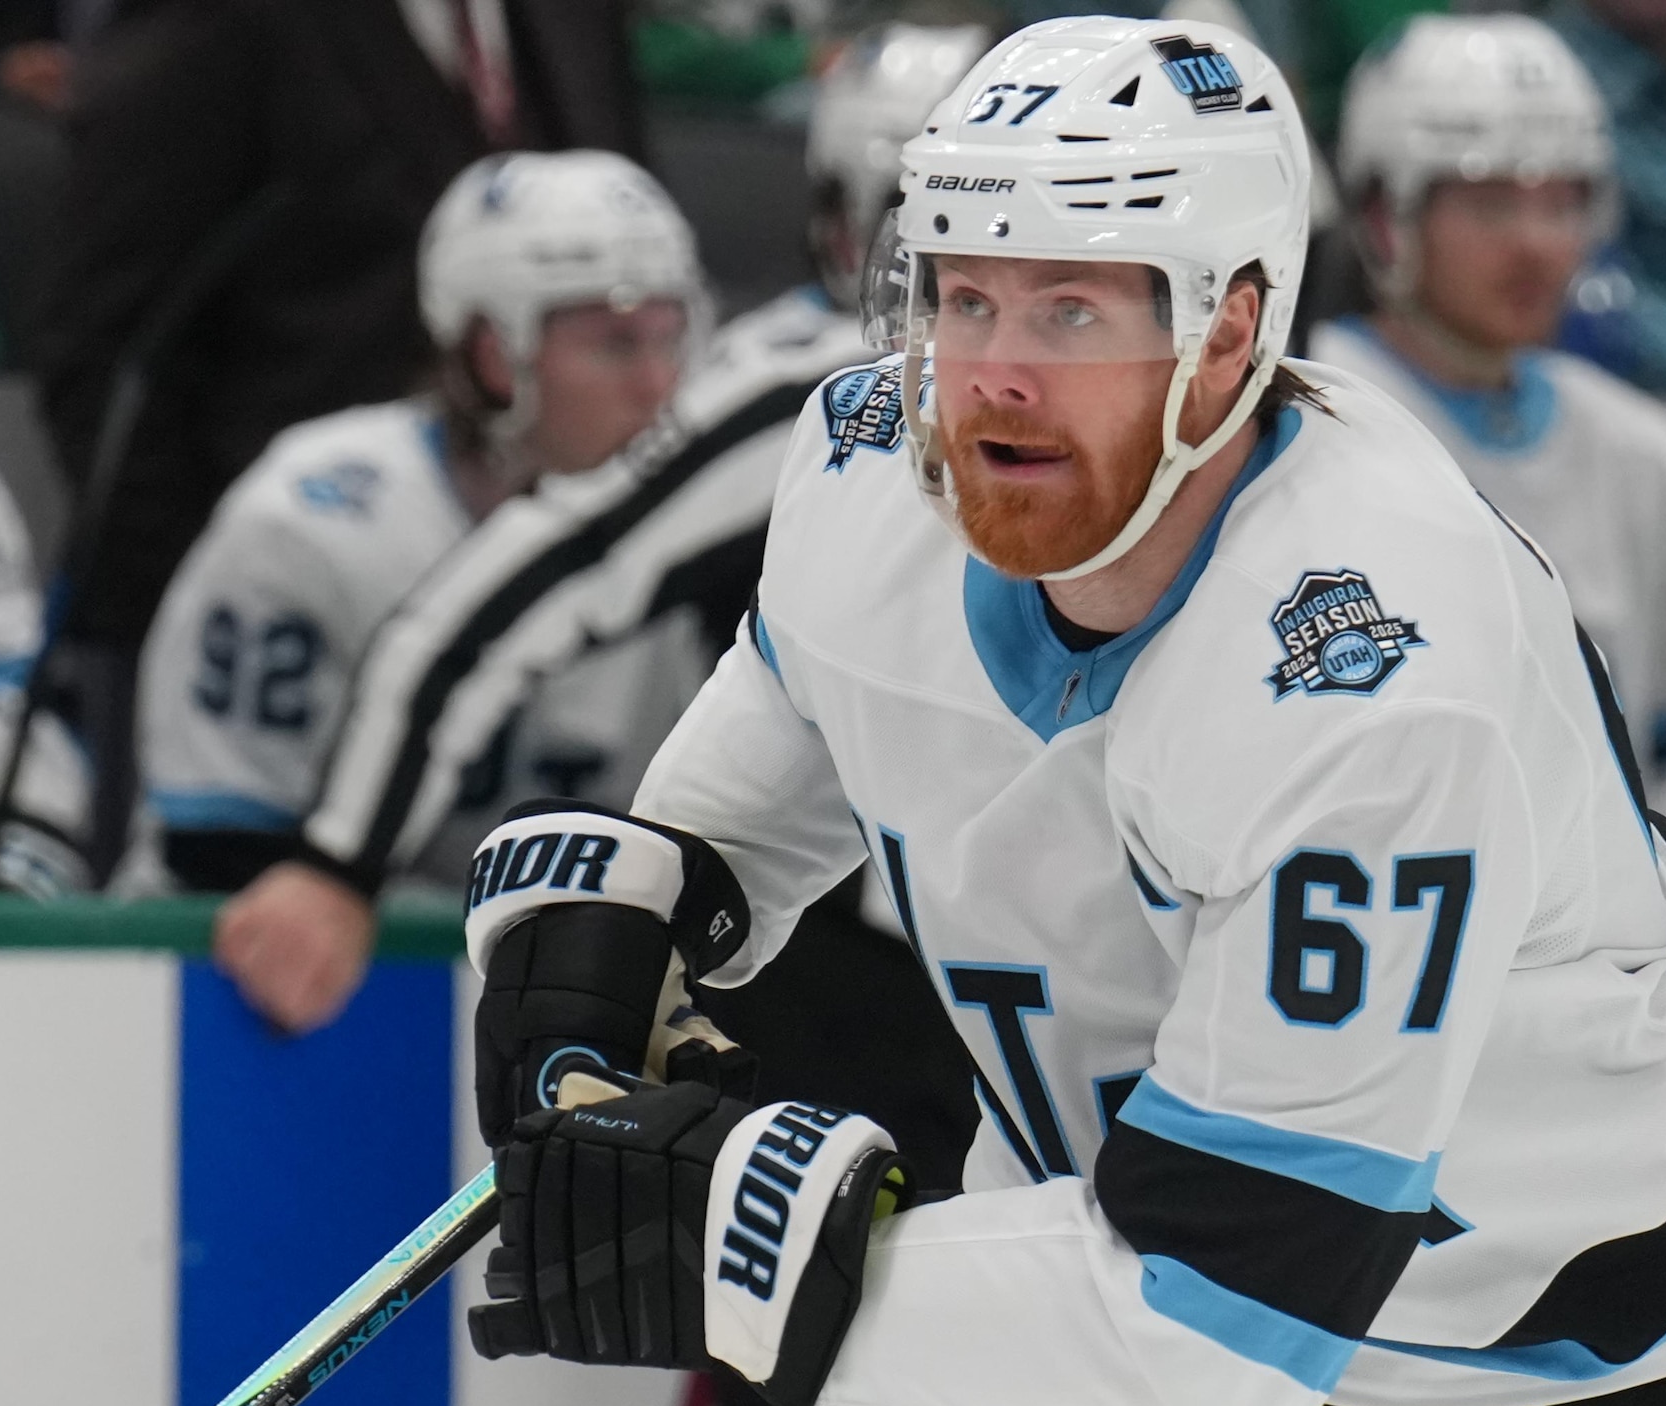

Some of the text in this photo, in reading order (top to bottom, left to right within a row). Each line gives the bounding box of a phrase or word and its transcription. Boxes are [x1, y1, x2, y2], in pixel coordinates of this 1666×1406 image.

[1159, 53, 1243, 95] UTAH
[926, 174, 1017, 193] BAUER
[837, 374, 869, 409] UTAH
[840, 419, 859, 454] 2025
[1277, 582, 1372, 635] INAUGURAL
[1284, 598, 1382, 656] SEASON
[1281, 621, 1405, 679] 2024 2025
[1327, 645, 1374, 673] UTAH
[471, 833, 620, 909] RIOR
[708, 909, 734, 943] 67
[1266, 847, 1475, 1034] 67
[413, 1173, 491, 1250] BAUE
[718, 1100, 851, 1303] RRIOR
[305, 1286, 411, 1391] NEXUS
